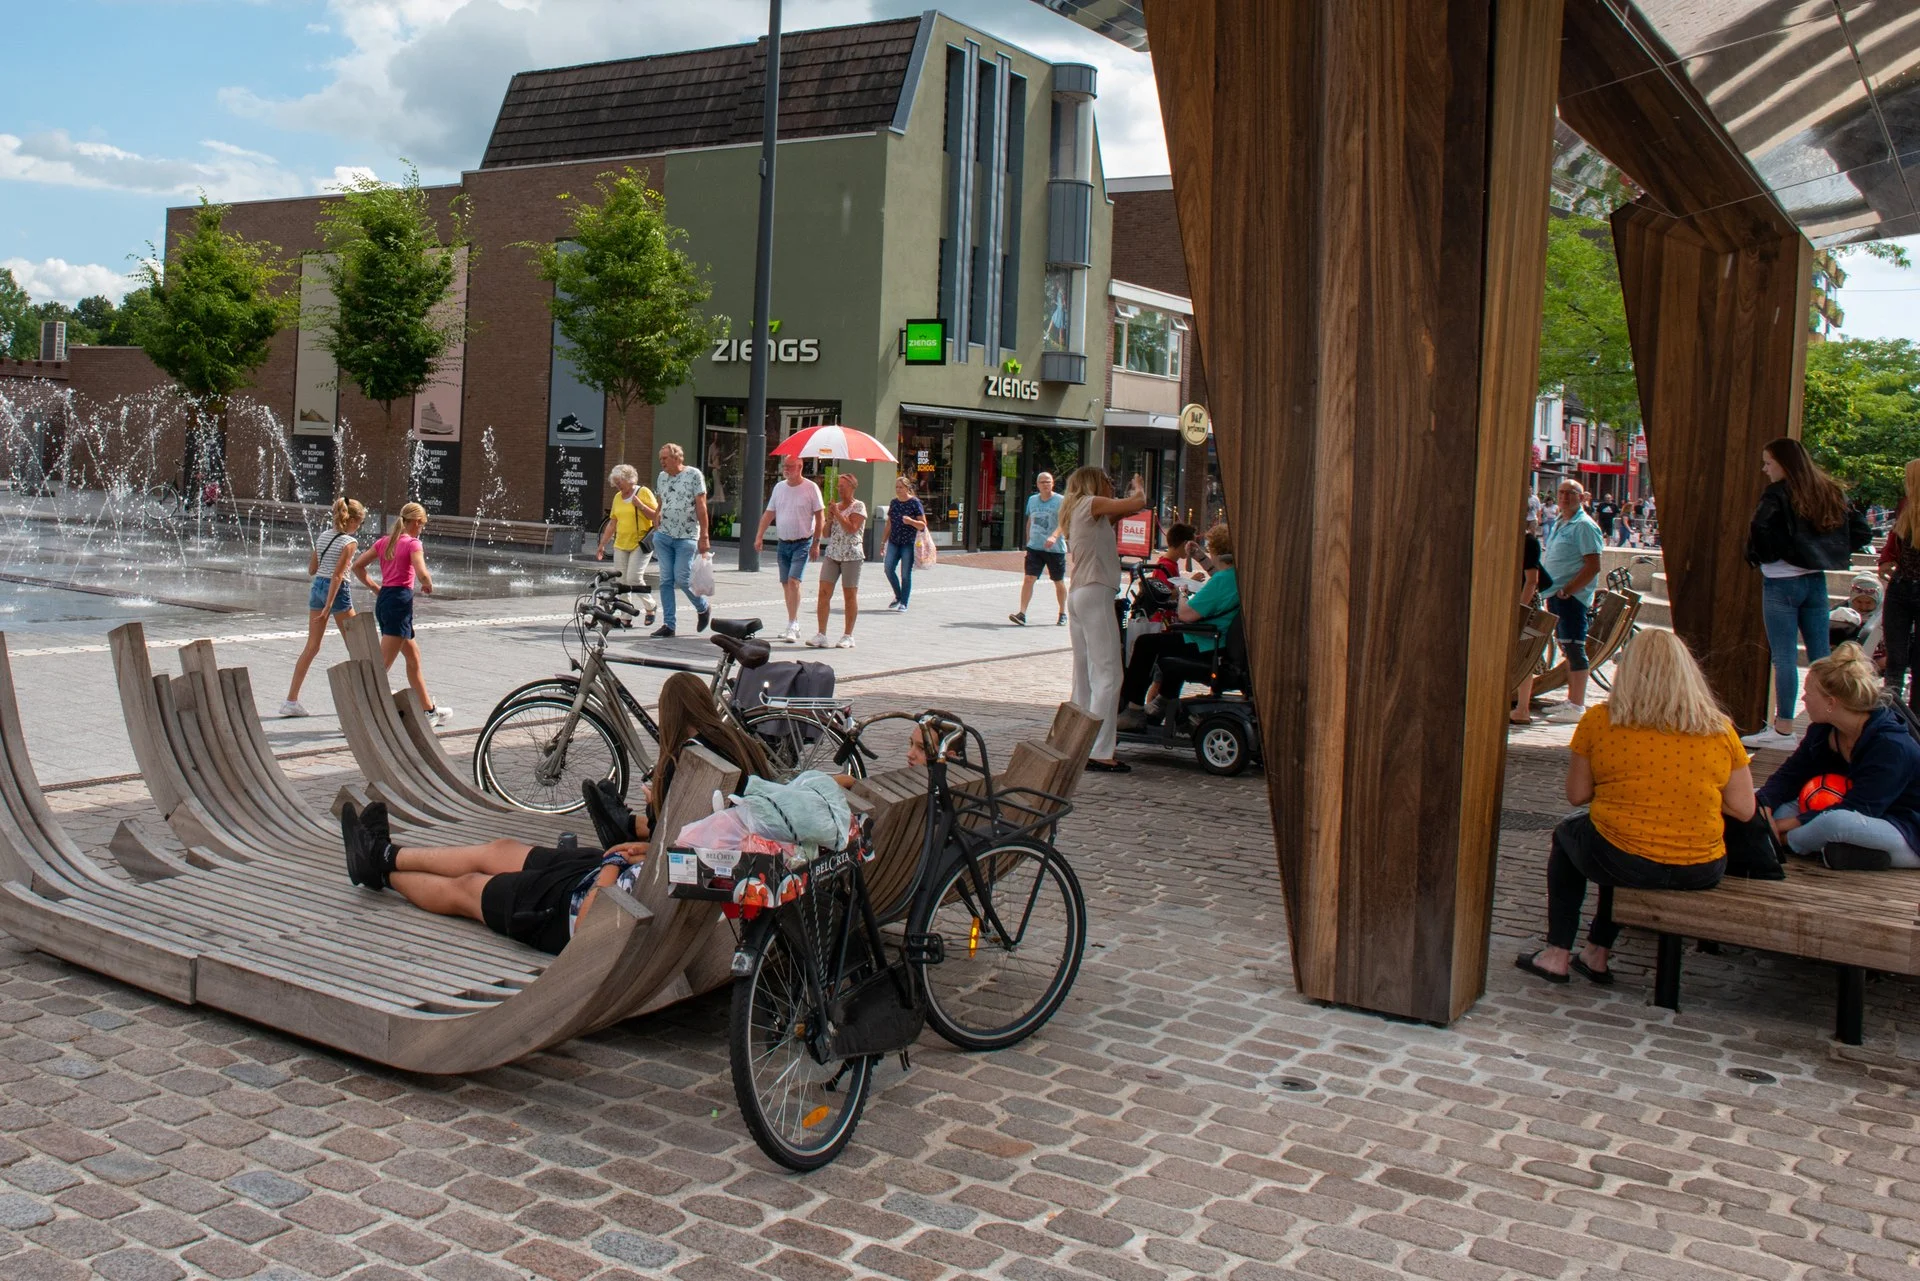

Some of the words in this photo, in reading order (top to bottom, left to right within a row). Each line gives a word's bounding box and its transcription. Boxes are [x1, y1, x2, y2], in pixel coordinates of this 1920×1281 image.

[908, 339, 937, 347] ZIENGS
[987, 375, 1039, 401] ZIENGS
[917, 450, 929, 458] NEXT
[917, 464, 936, 472] SCHOOL
[1123, 526, 1145, 535] SALE
[705, 852, 735, 861] BELORTA
